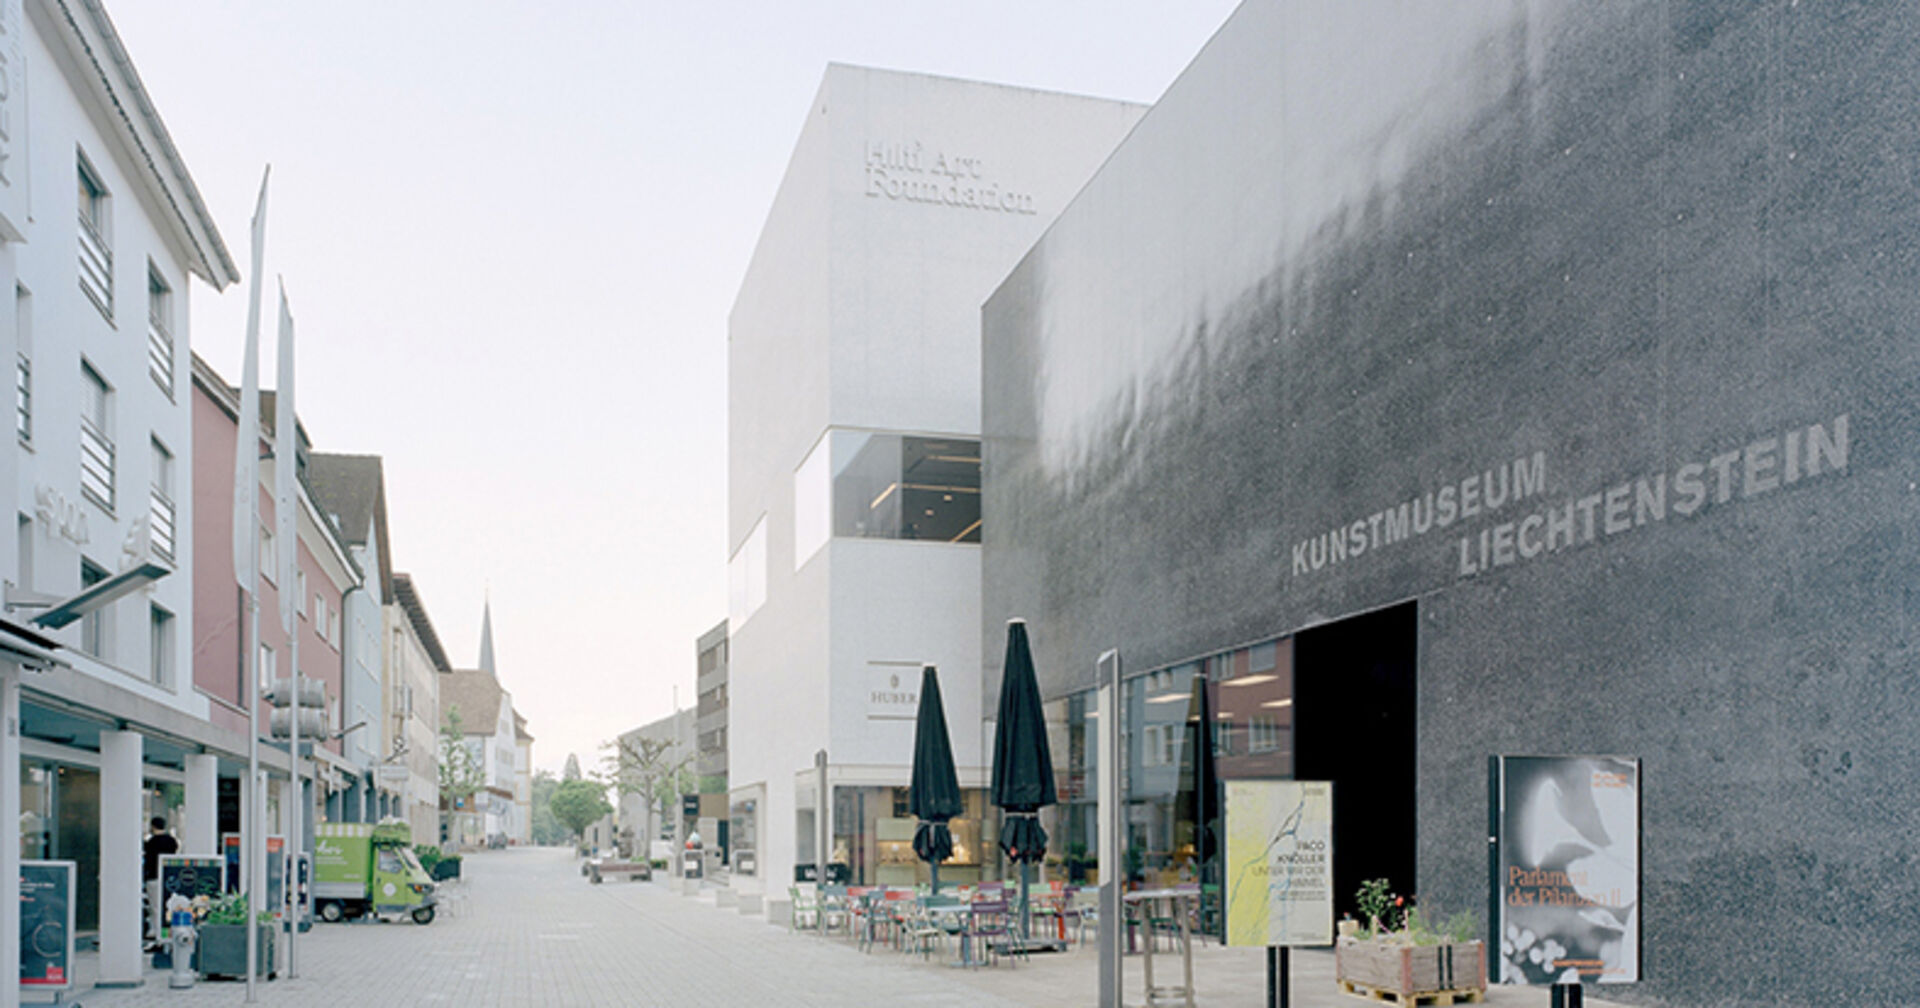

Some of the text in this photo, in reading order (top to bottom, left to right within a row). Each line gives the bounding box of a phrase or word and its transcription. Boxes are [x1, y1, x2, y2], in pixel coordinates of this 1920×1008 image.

[864, 139, 981, 178] Hilti Art
[864, 167, 1037, 215] Foundation
[1292, 450, 1546, 577] KUNSTMUSEUM
[1460, 413, 1850, 575] LIECHTENSTEIN
[870, 691, 917, 704] HUBER
[1509, 865, 1588, 887] Parlament
[1507, 886, 1535, 907] der
